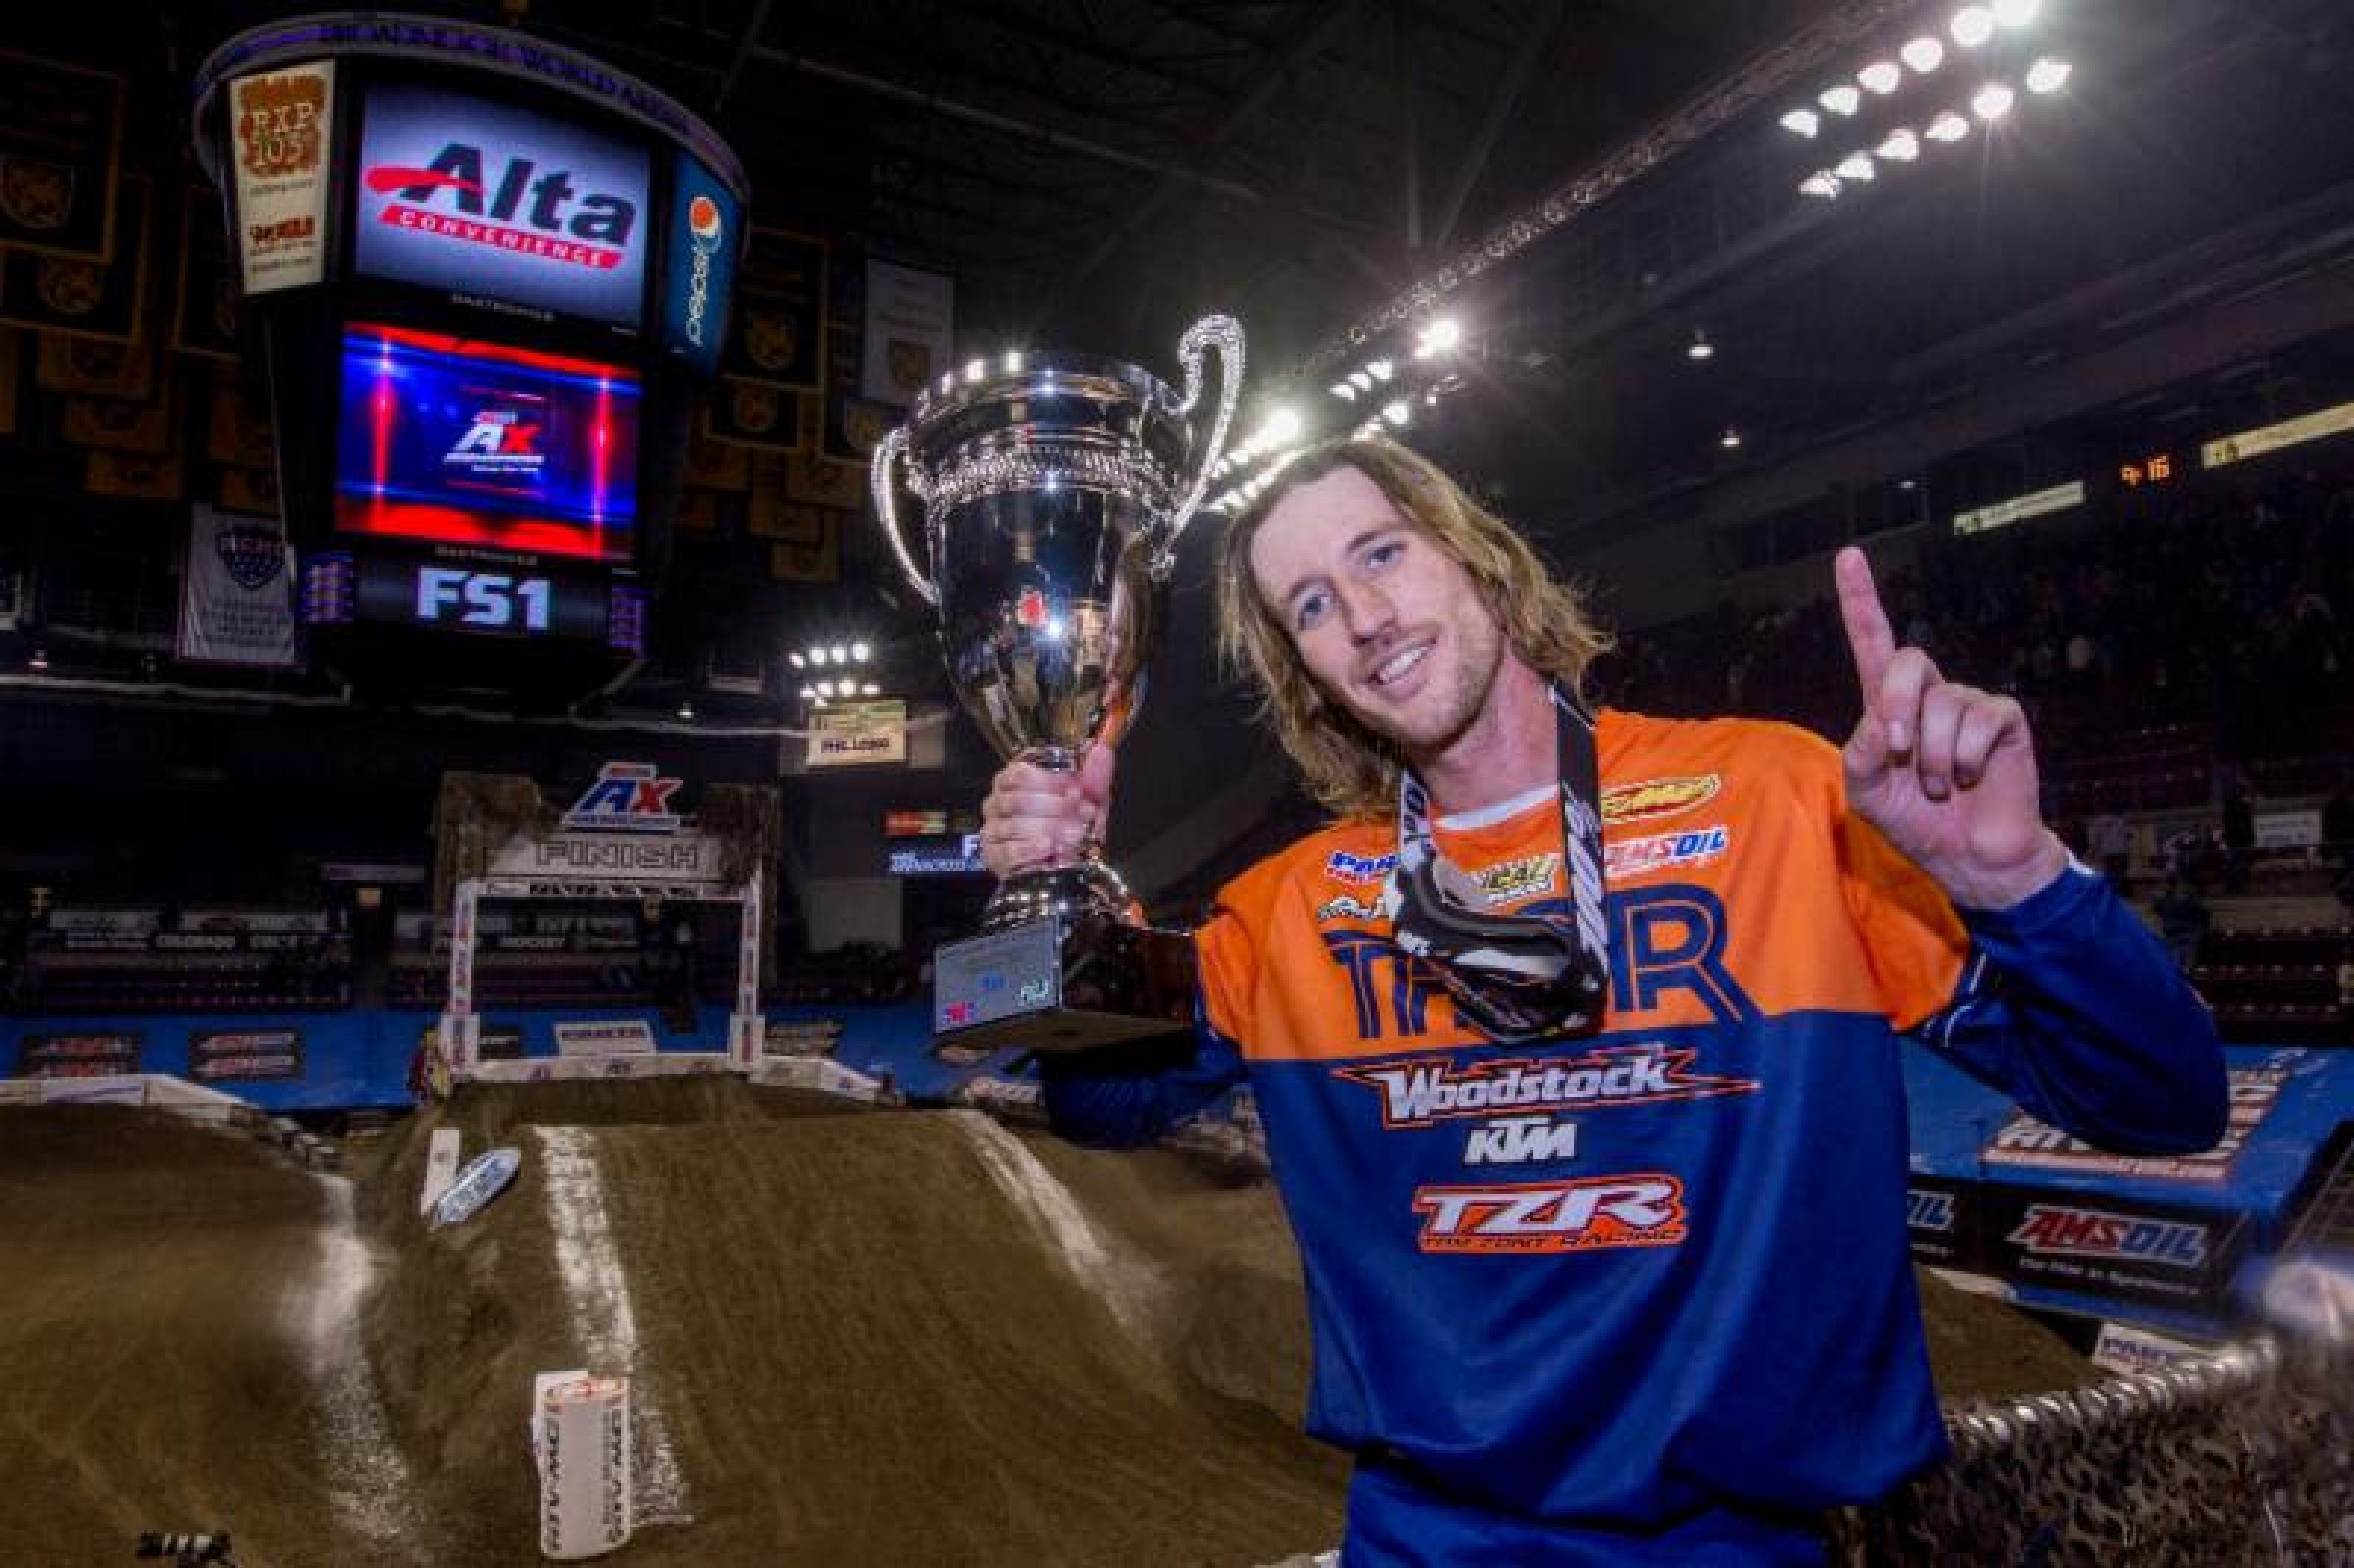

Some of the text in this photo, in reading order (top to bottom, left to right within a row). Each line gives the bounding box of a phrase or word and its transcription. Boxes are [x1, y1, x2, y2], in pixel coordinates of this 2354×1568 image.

[397, 141, 636, 247] Alta
[397, 209, 605, 268] CONVENIENCE
[686, 241, 713, 346] pepsi
[416, 566, 550, 631] FS1
[535, 840, 699, 870] FINISH
[1321, 883, 1766, 1041] THR
[1368, 1044, 1673, 1122] Woodstock
[1463, 1118, 1578, 1164] KTM
[1425, 1182, 1675, 1234] TZR
[2021, 1210, 2204, 1261] AMSOIL
